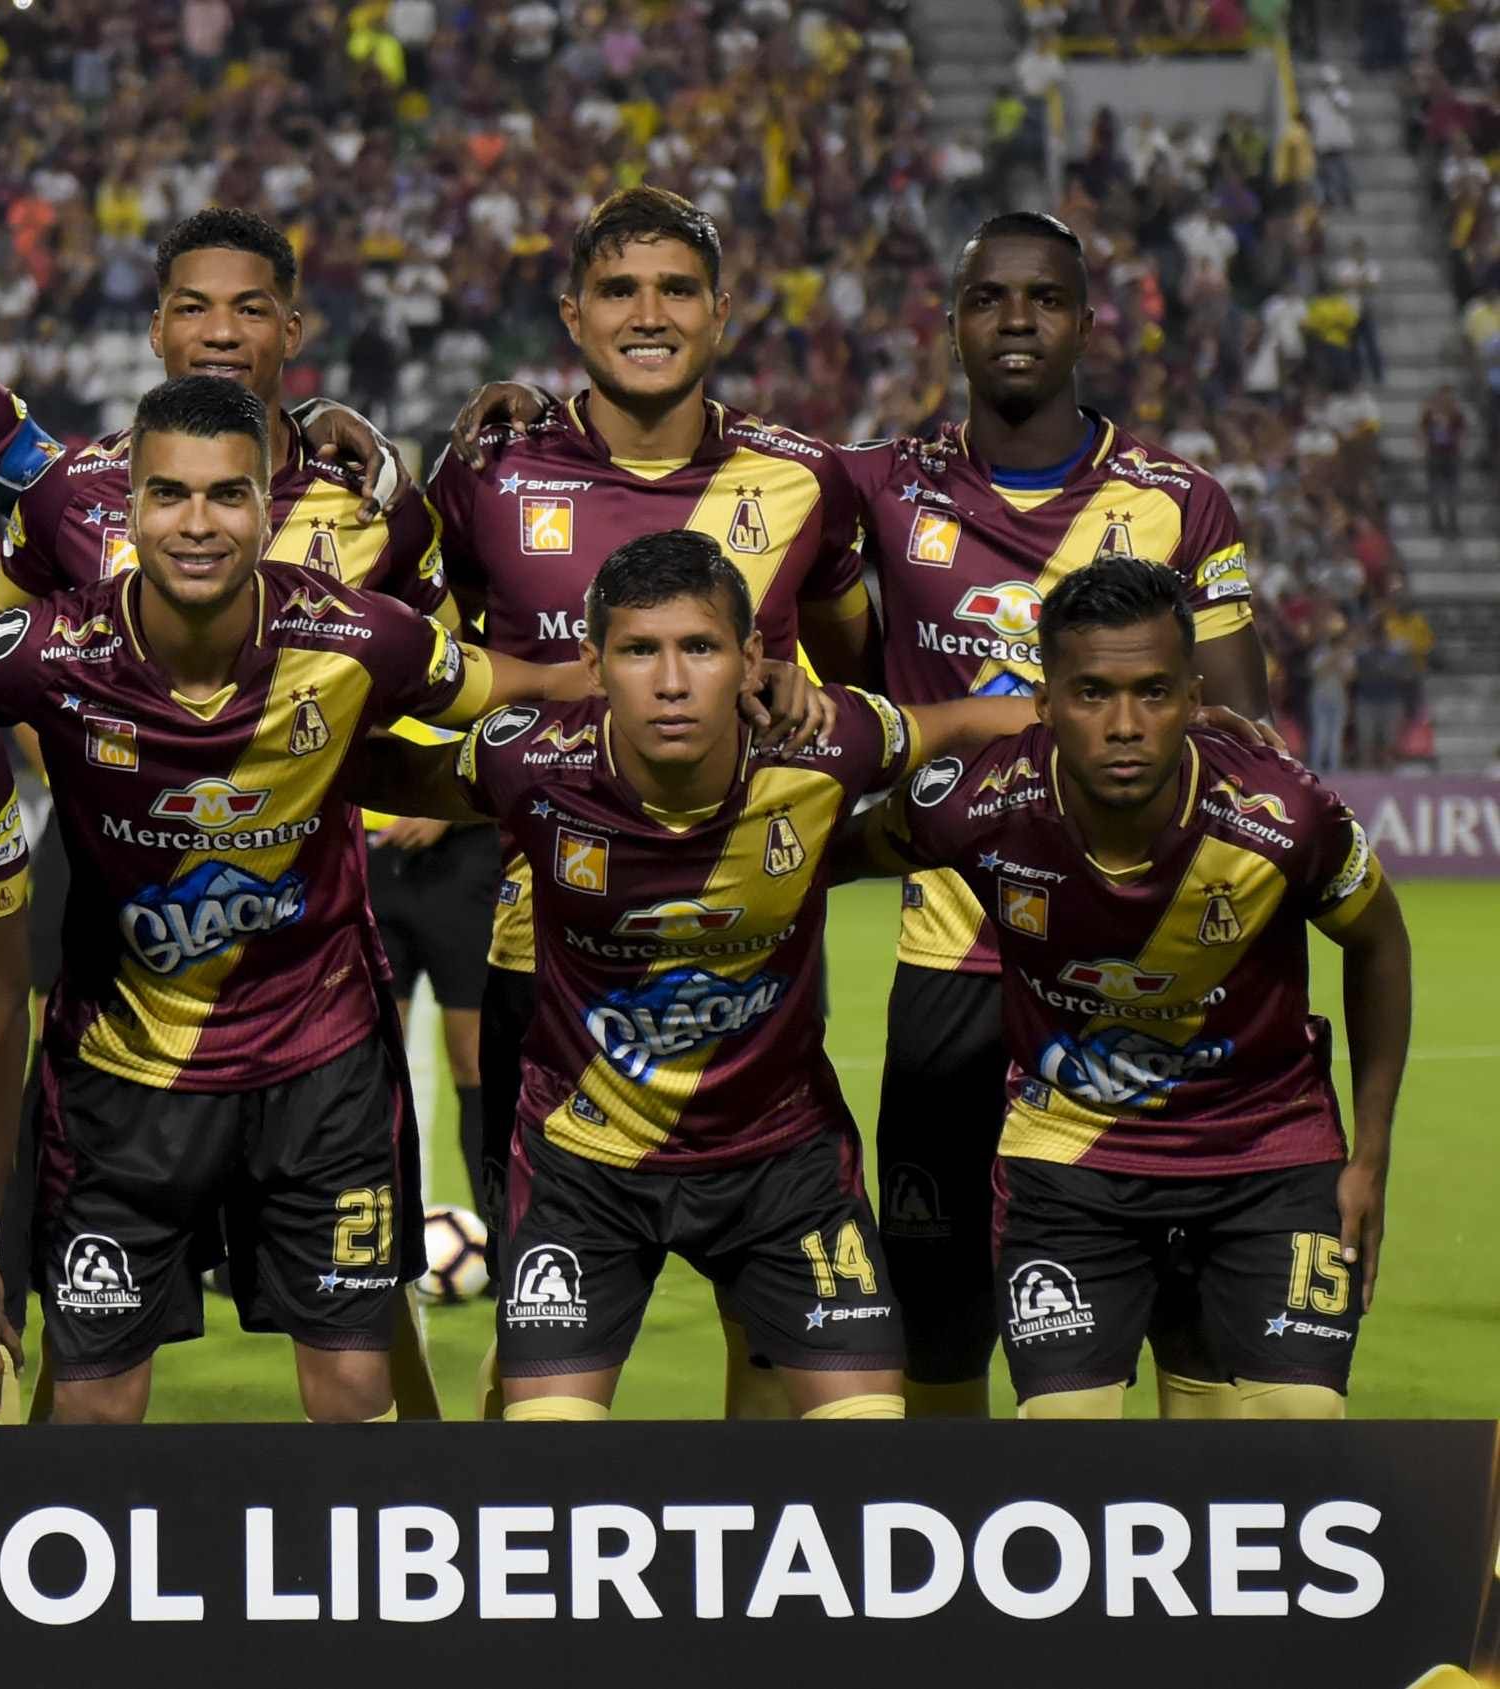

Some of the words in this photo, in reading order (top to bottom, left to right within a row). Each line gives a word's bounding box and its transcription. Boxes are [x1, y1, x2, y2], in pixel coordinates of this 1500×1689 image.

[727, 428, 823, 458] Multicentro
[526, 480, 593, 491] SHEFFY
[270, 617, 372, 641] Multicentro
[917, 621, 1041, 664] Mercace
[100, 813, 323, 852] Mercacentro
[1200, 799, 1295, 849] Multicentro
[1367, 796, 1500, 857] AIR
[1002, 861, 1068, 885] SHEFFY
[563, 922, 797, 959] Mercacentro
[333, 1184, 393, 1266] 21
[801, 1219, 878, 1297] 14
[1287, 1232, 1350, 1316] 15
[57, 1288, 141, 1304] Comfenalco
[506, 1302, 587, 1317] Comfenalco
[508, 1320, 585, 1330] TOLIMA
[831, 1306, 891, 1321] SHEFFY
[1010, 1310, 1094, 1337] Comfenalco
[1293, 1322, 1353, 1342] SHEFFY
[245, 1500, 1386, 1622] LIBERTADORES
